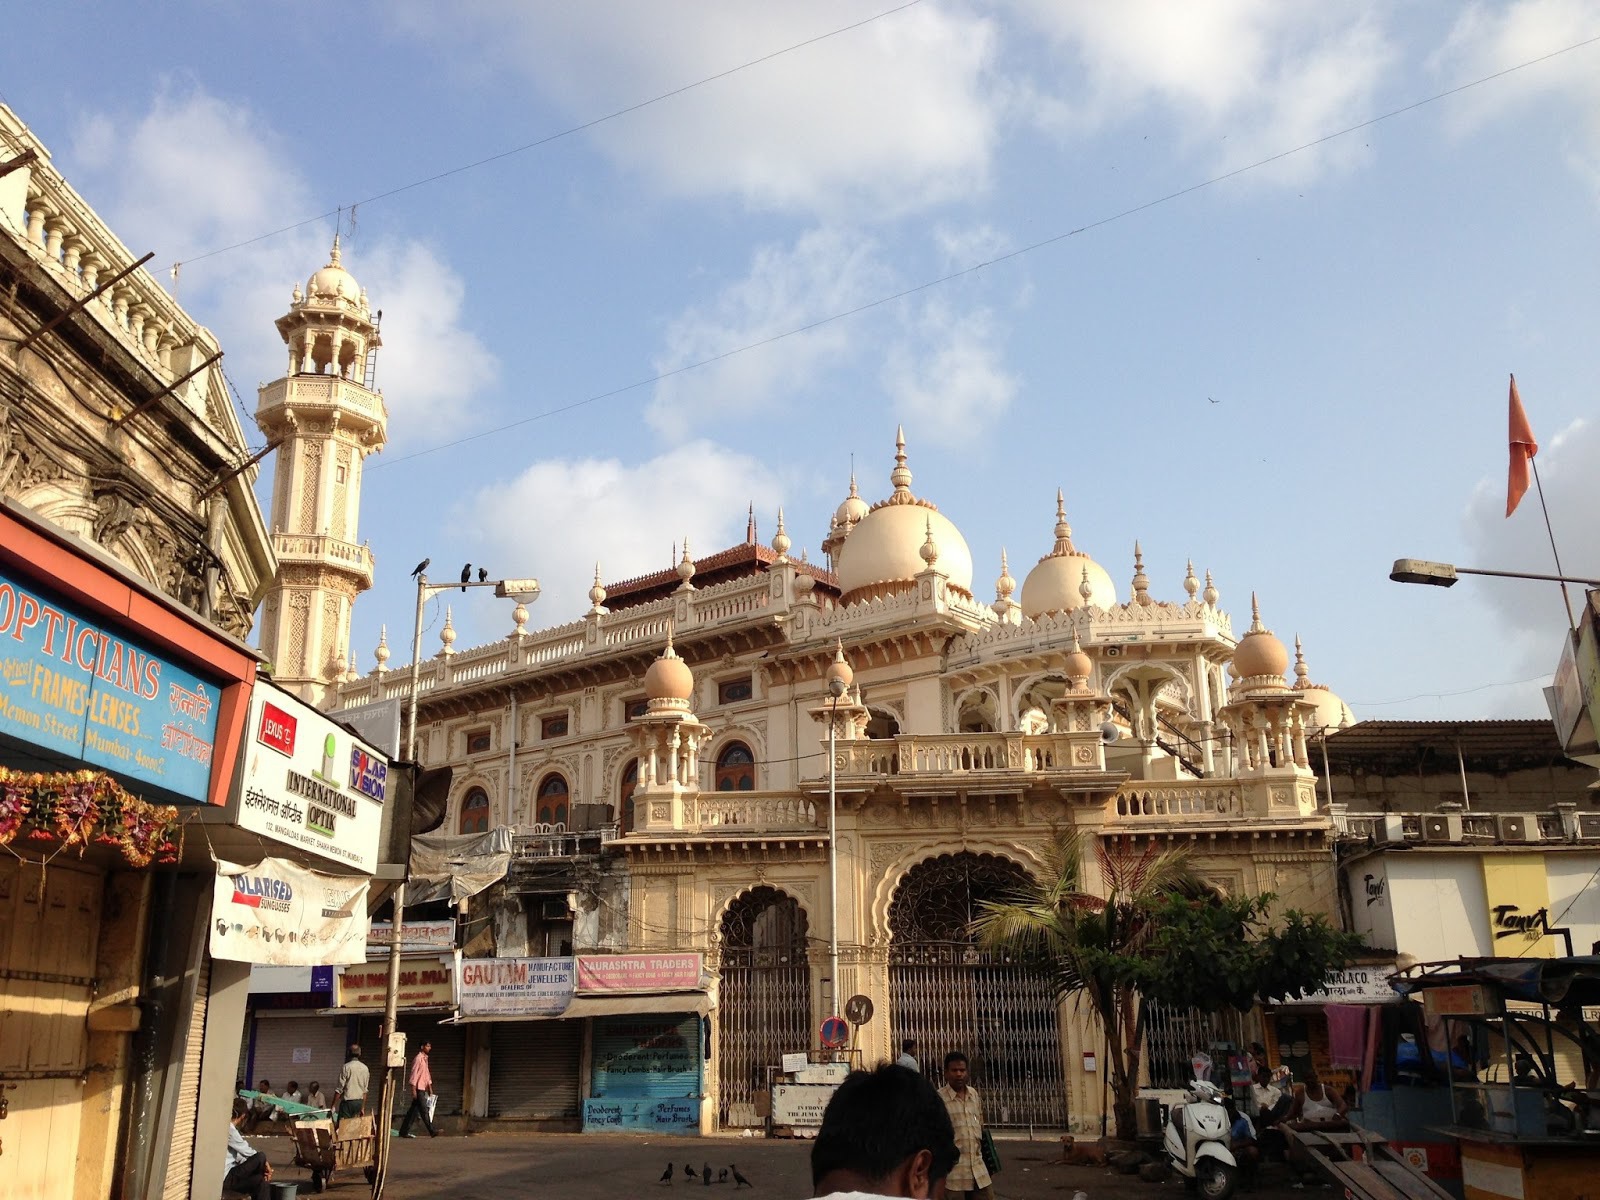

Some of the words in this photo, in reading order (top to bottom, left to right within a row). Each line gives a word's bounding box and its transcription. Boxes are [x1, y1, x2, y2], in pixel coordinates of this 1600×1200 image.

[0, 583, 162, 701] OPTICIANS
[265, 717, 283, 740] LEXUS
[288, 770, 357, 819] INTERNATIONAL
[309, 805, 337, 832] OPTIK
[260, 899, 291, 913] SUNGLASSES
[463, 963, 528, 987] GAUTAM
[650, 959, 695, 970] TRADERS
[528, 974, 568, 984] JEWELLERS
[780, 1089, 786, 1097] P
